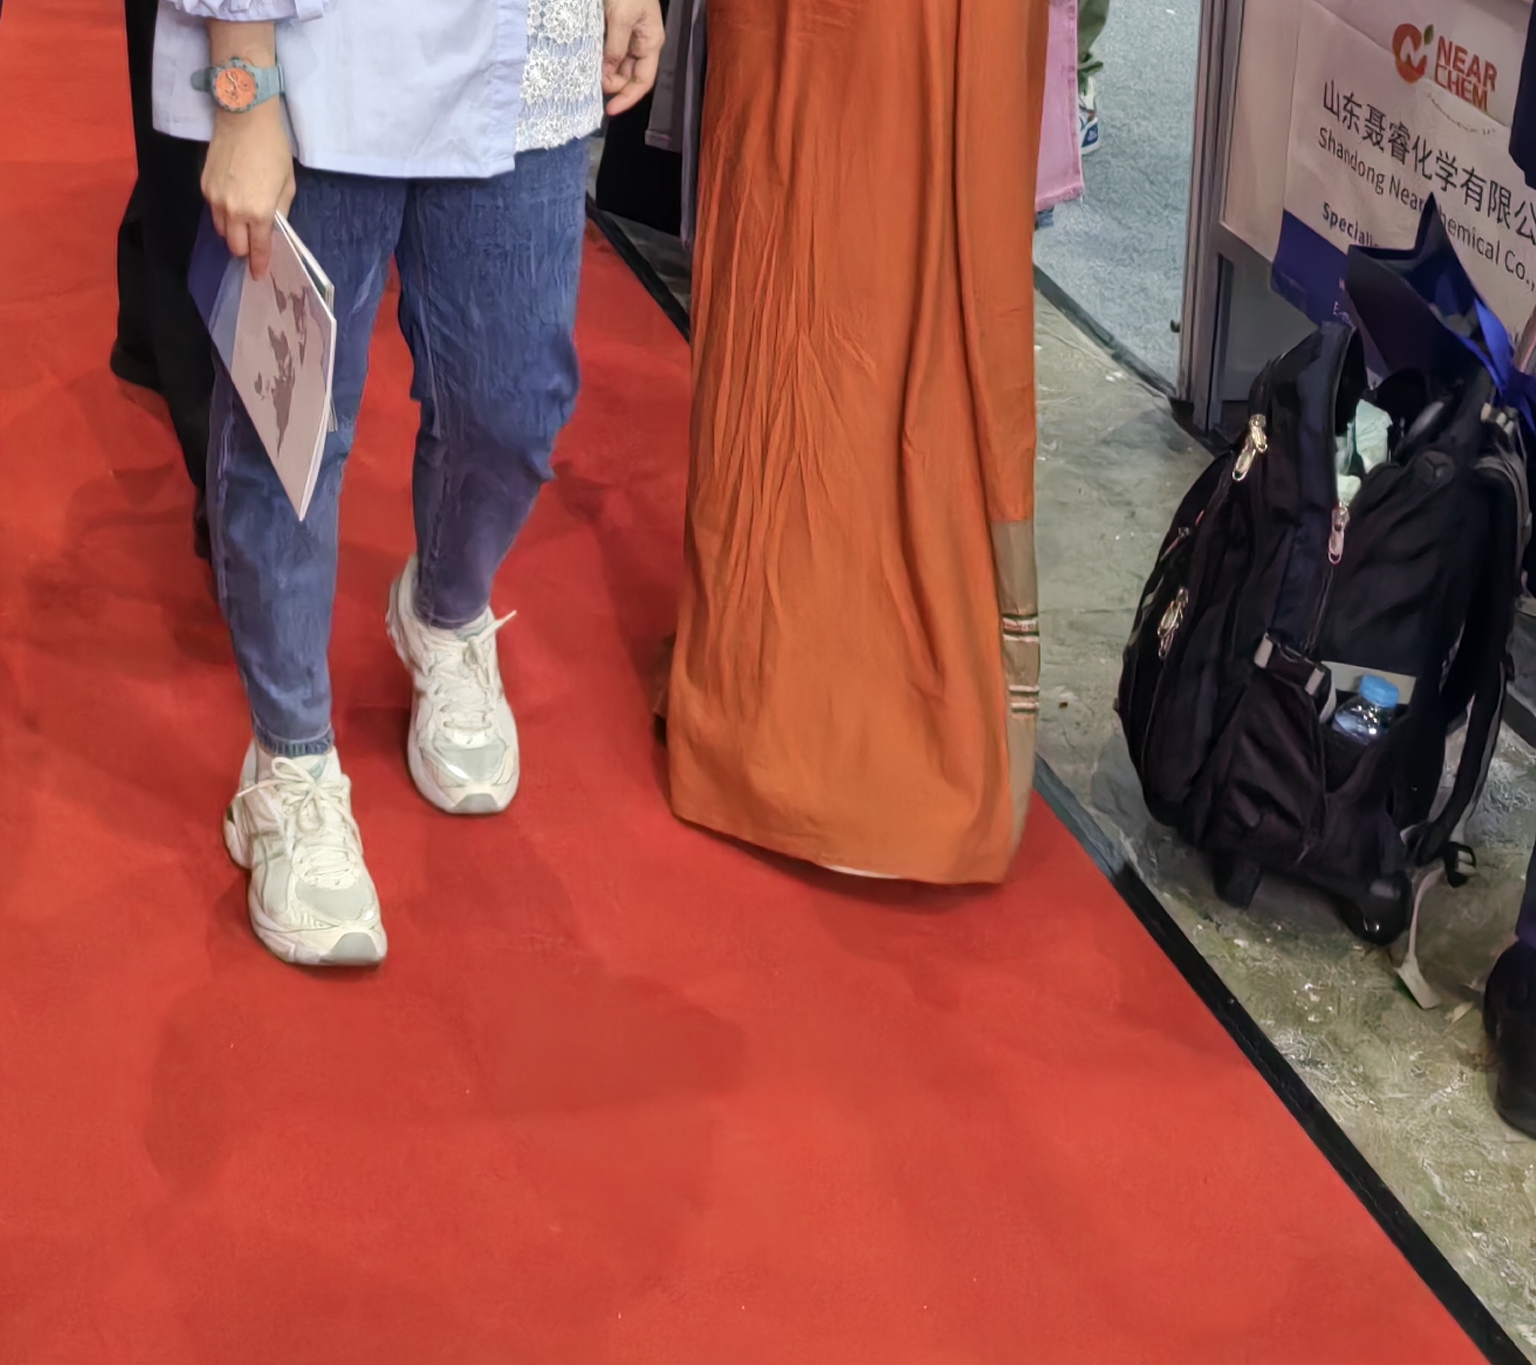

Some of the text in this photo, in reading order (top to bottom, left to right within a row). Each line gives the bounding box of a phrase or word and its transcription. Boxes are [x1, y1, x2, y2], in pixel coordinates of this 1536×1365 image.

[1434, 64, 1488, 112] CHEM
[1437, 35, 1497, 91] NEAR
[1318, 127, 1386, 195] Shandong
[1389, 175, 1424, 214] Near
